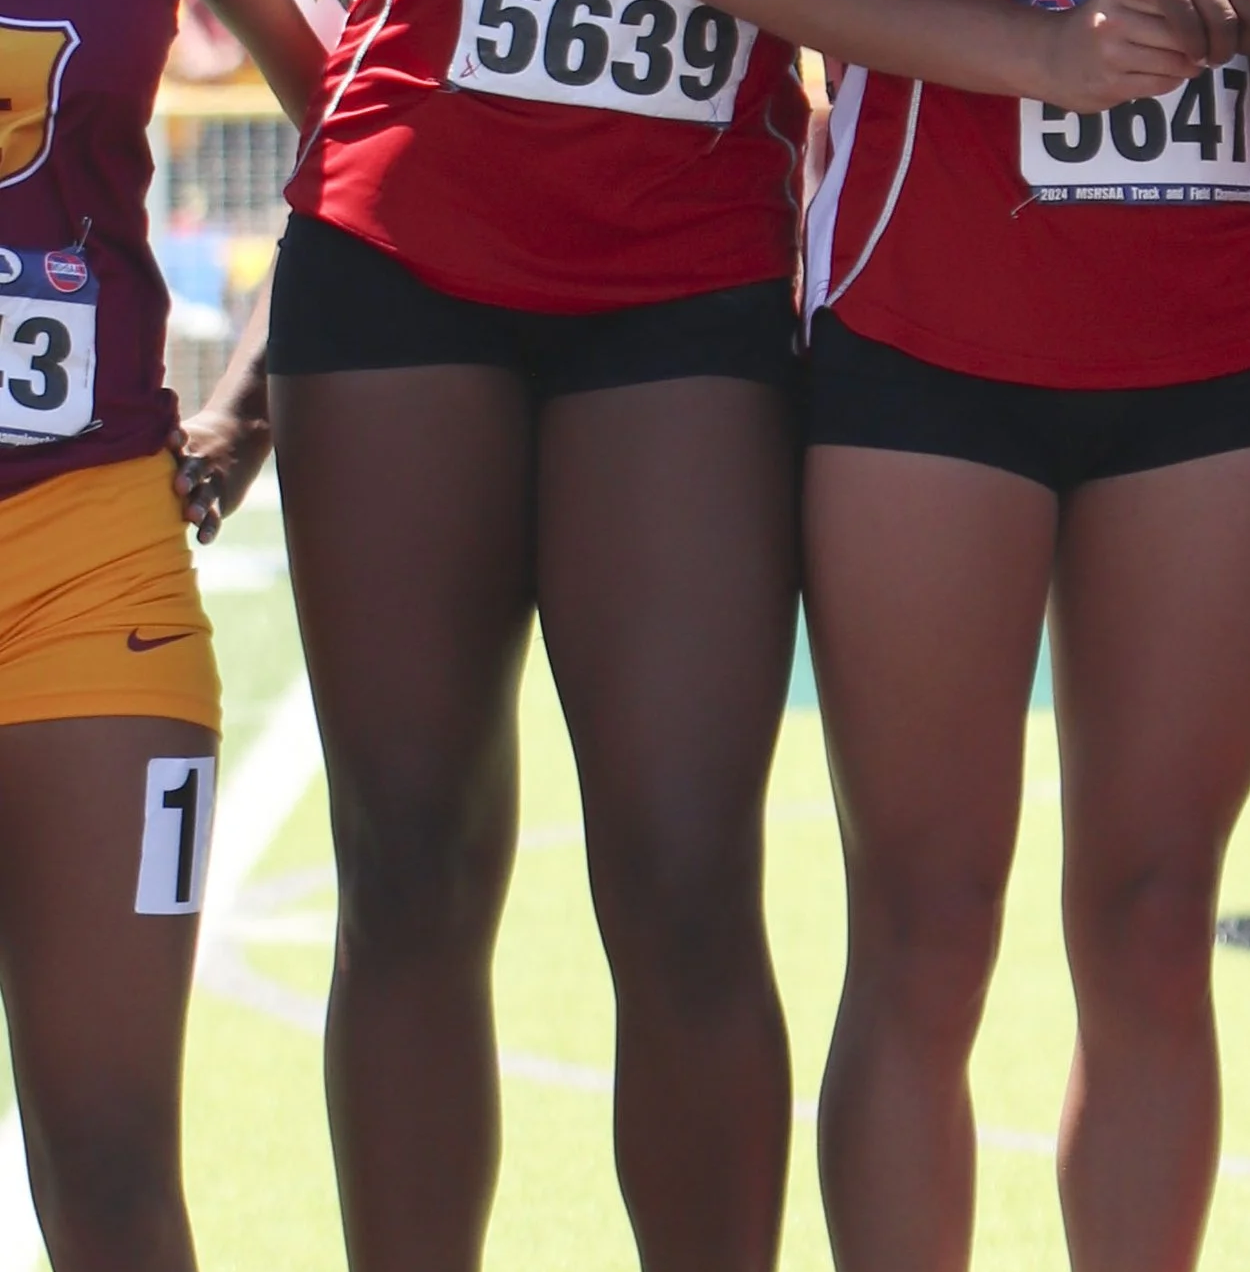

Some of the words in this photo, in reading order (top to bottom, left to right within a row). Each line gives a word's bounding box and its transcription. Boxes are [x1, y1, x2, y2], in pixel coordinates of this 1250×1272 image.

[1042, 65, 1250, 163] 5647
[1040, 187, 1068, 201] 2024
[1075, 186, 1124, 201] MSHSAA
[1131, 186, 1160, 201] Track
[1165, 187, 1184, 201] and
[1190, 186, 1211, 201] Field
[163, 767, 198, 903] 1
